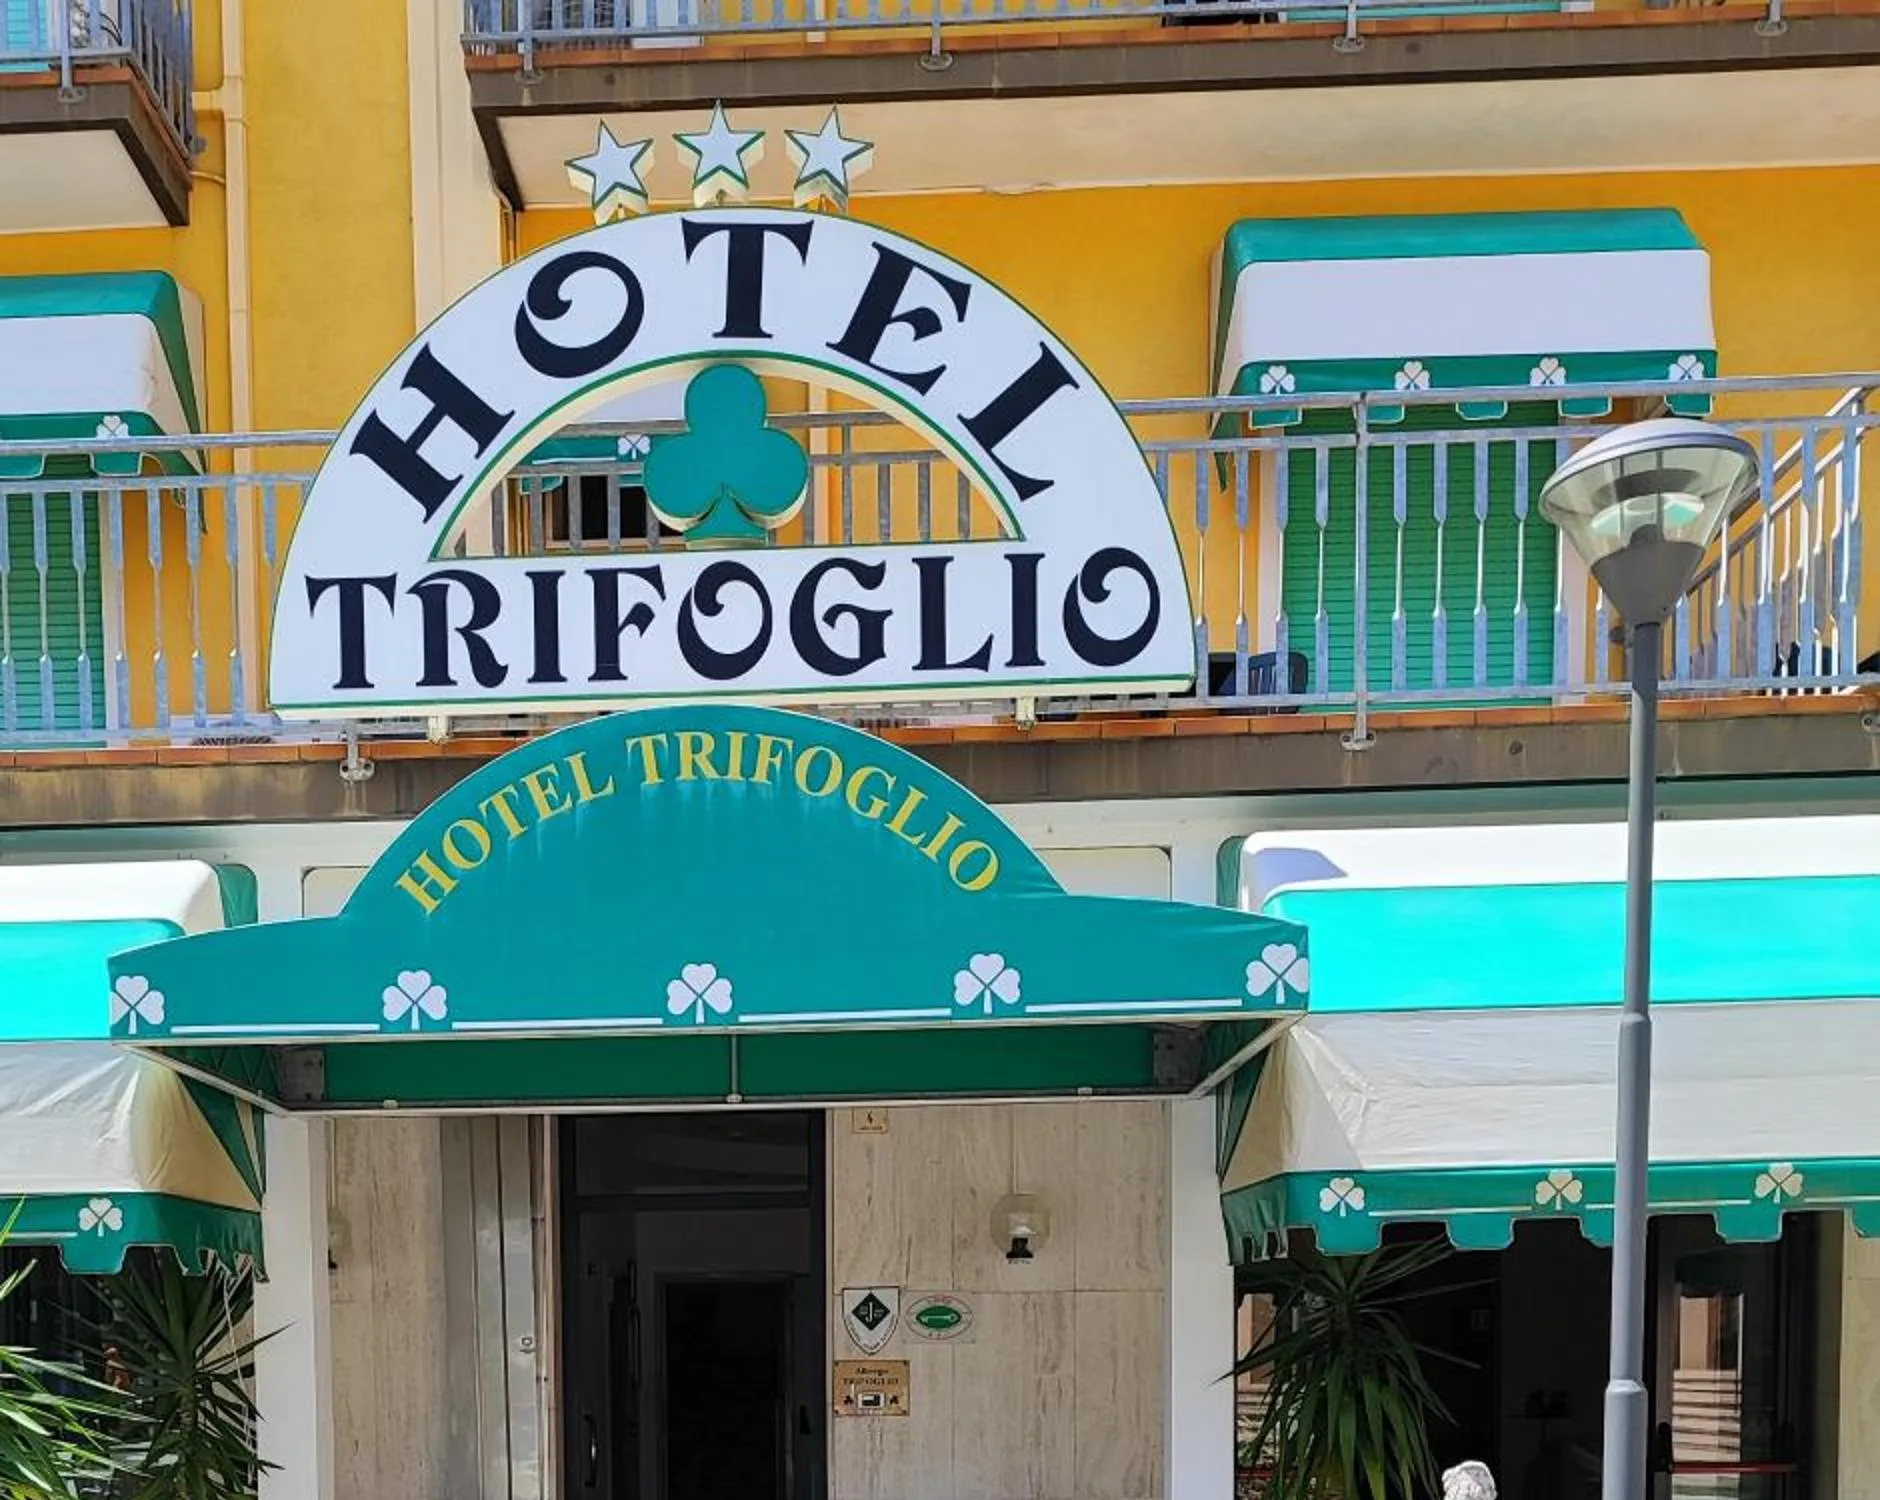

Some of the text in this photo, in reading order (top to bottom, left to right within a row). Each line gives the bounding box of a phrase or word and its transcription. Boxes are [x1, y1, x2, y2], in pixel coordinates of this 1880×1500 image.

[348, 217, 1080, 524] HOTEL
[305, 546, 1162, 690] TRIFOGLIO
[396, 730, 1001, 916] HOTEL TRIFOGLIO
